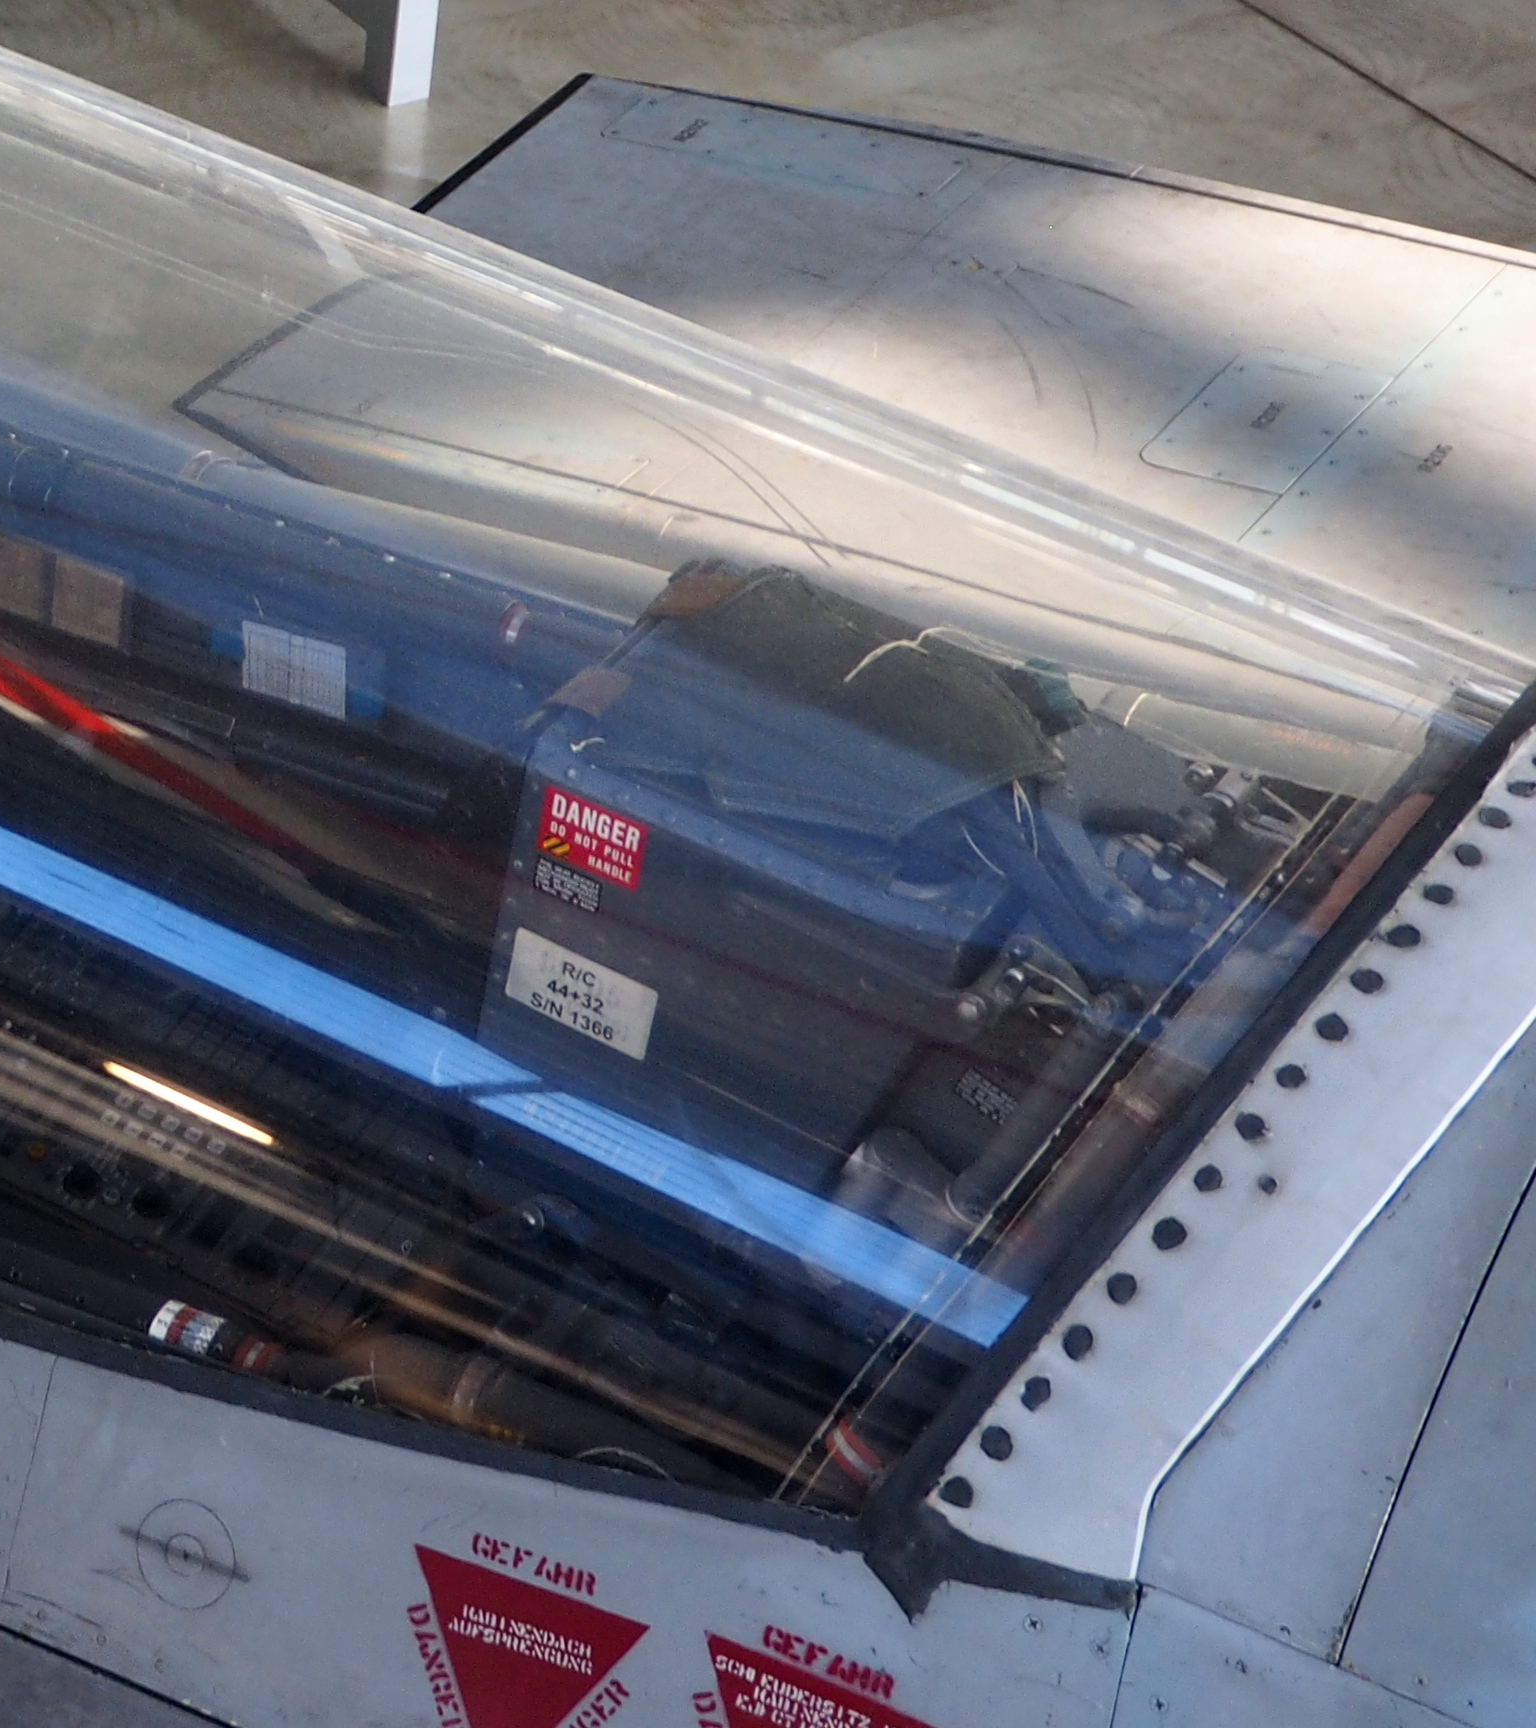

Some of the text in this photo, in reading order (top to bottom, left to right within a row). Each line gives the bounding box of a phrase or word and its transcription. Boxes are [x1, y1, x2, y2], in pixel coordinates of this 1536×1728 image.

[550, 821, 634, 869] DO NOT PULL
[551, 793, 640, 853] DANGER
[588, 855, 633, 883] HANDLE
[547, 980, 604, 1014] 44+32
[561, 962, 596, 988] R/C
[530, 991, 614, 1041] S/N 1366
[472, 1532, 597, 1596] GEFAHR
[448, 1617, 593, 1676] AUFSPRENGUNG
[762, 1624, 895, 1699] GEFAHR
[715, 1654, 872, 1728] SCHLEUDERSITZ
